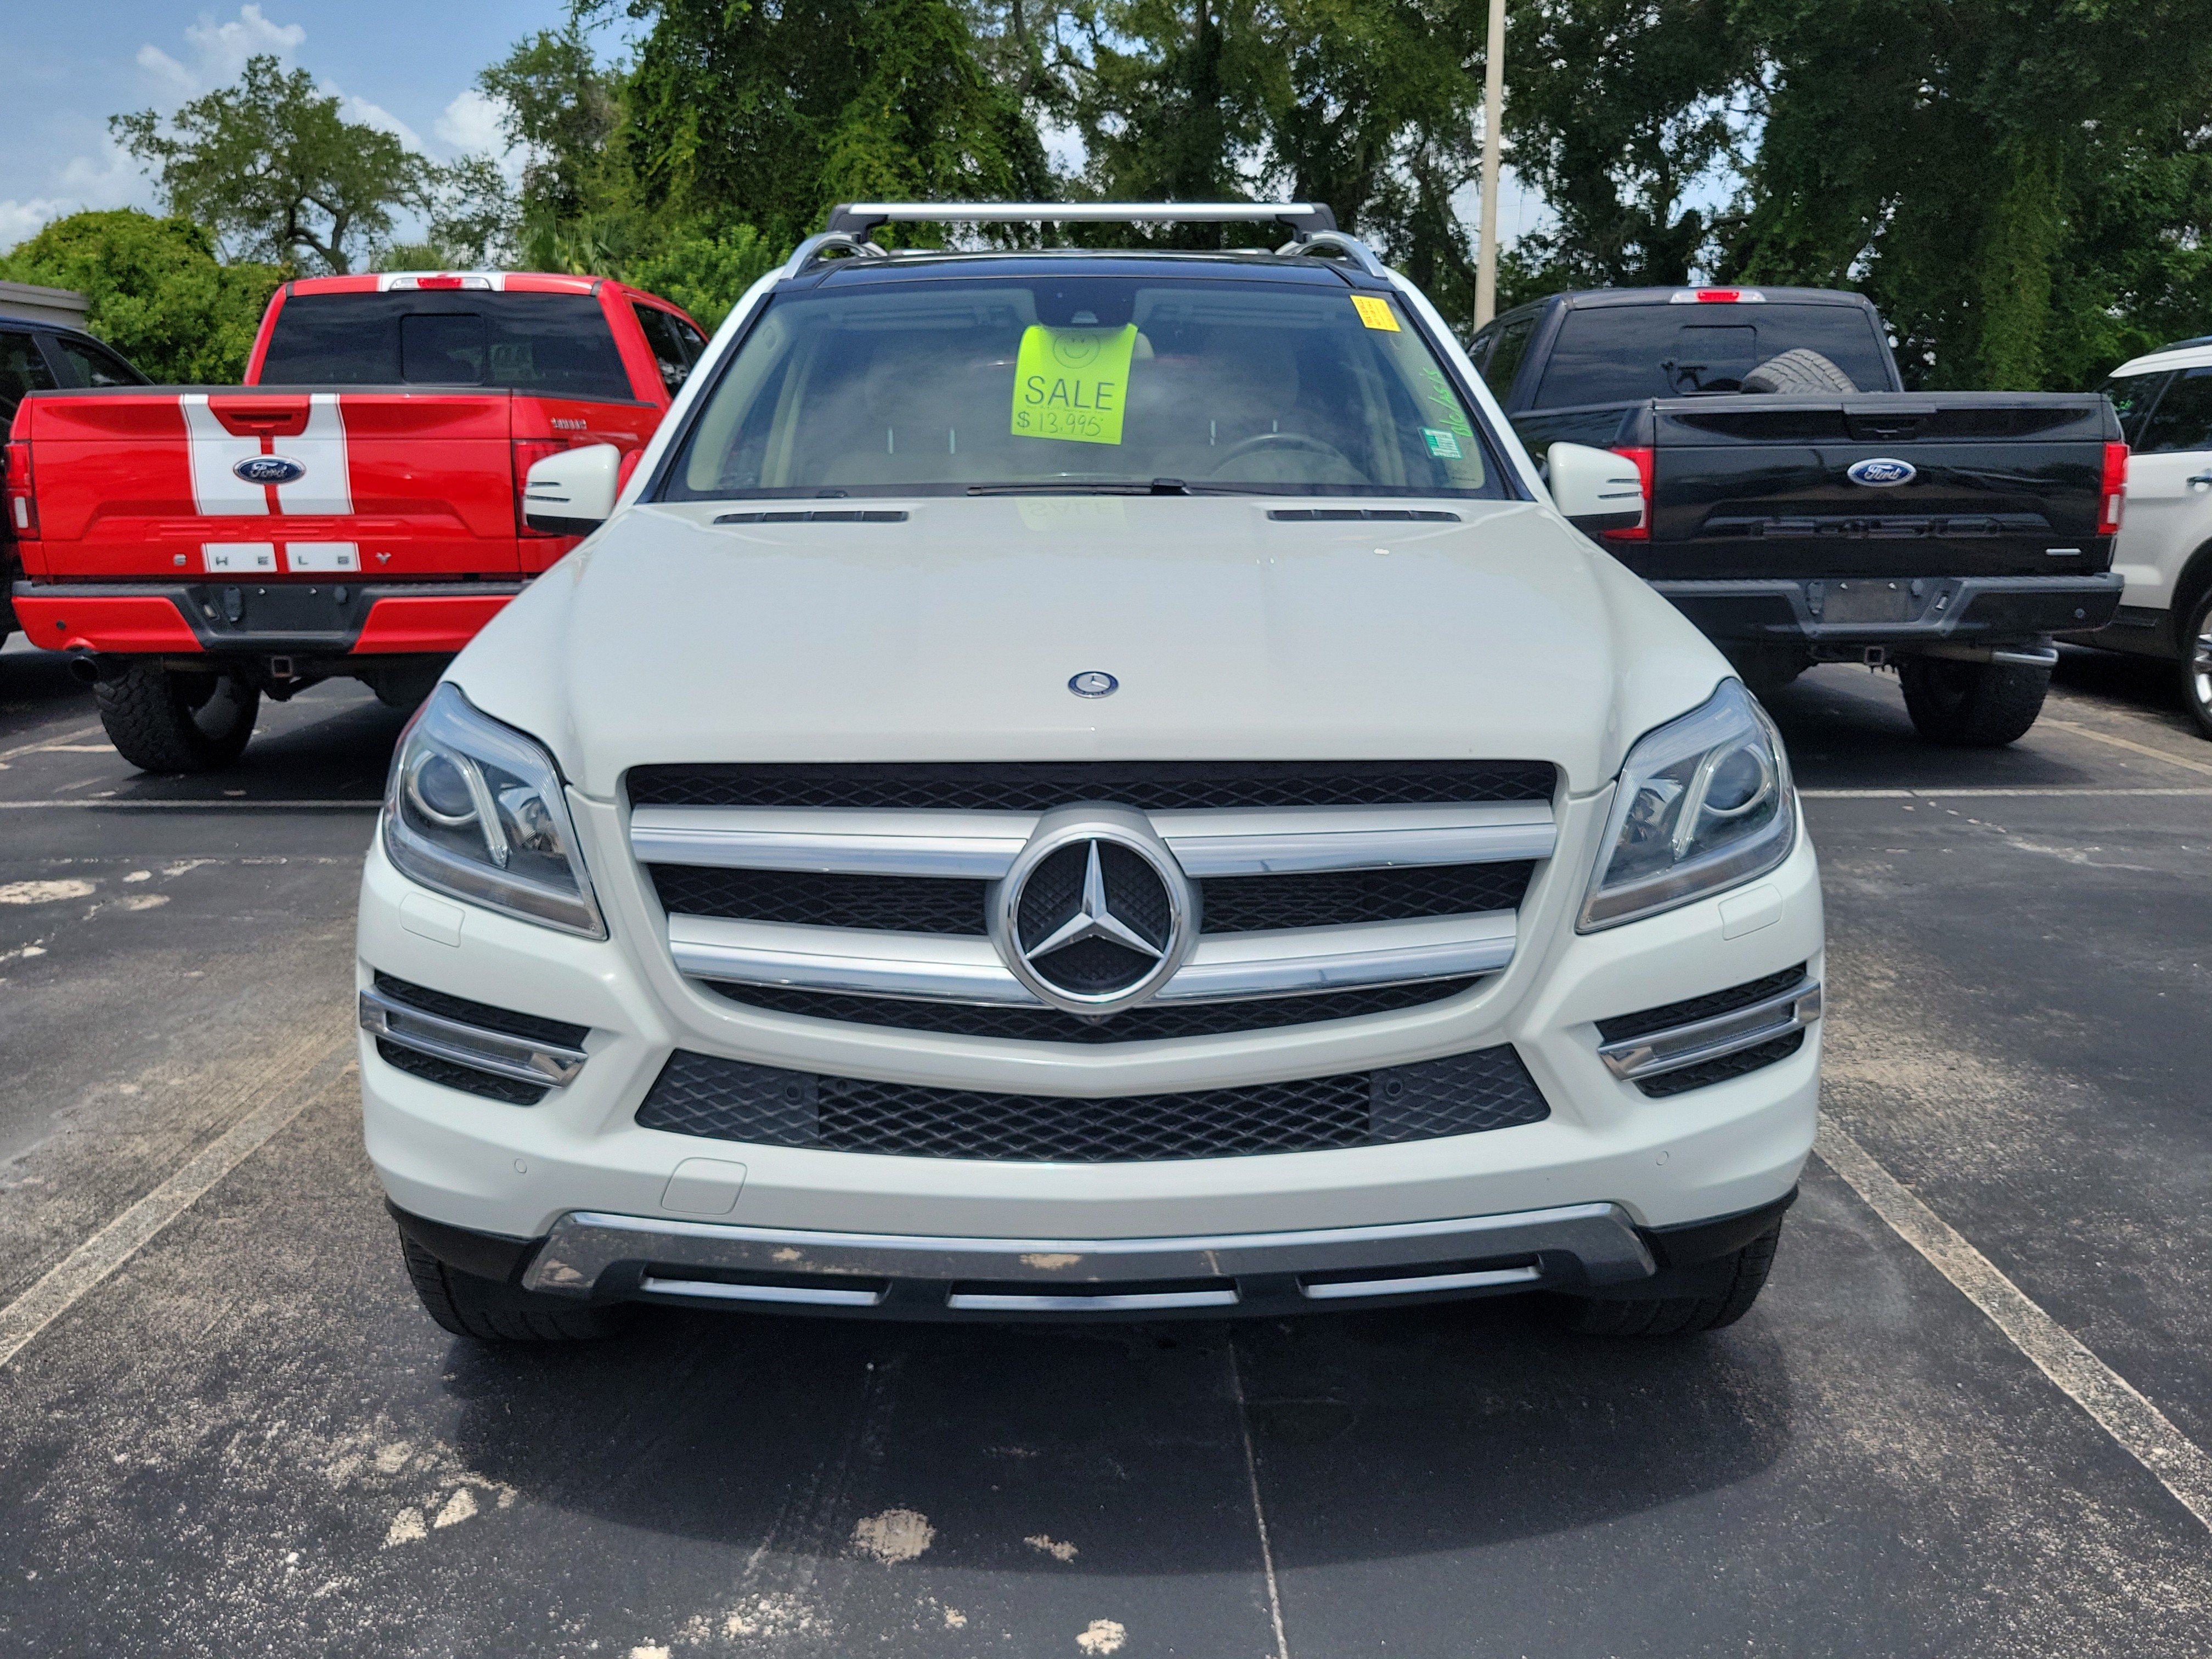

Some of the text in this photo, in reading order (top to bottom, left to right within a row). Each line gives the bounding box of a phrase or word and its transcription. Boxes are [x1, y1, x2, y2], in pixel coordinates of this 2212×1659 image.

[1025, 376, 1115, 410] SALE
[250, 461, 287, 478] Ford
[1864, 464, 1903, 480] Ford
[173, 551, 392, 567] SHELBY
